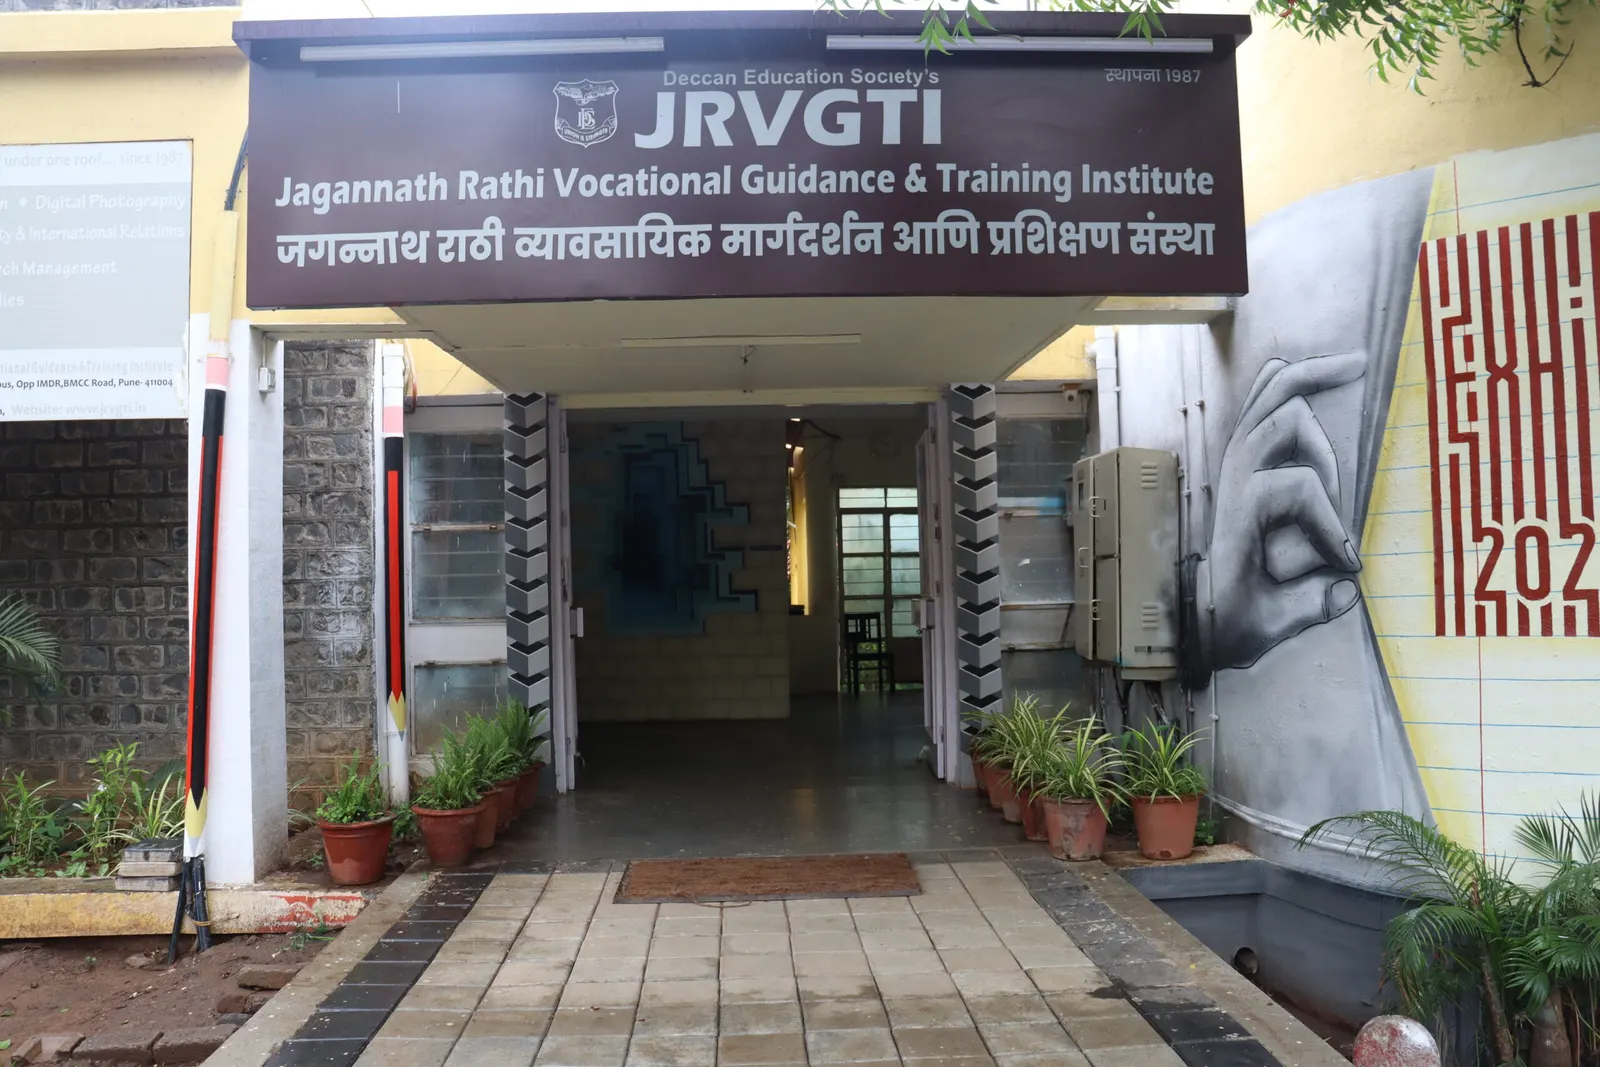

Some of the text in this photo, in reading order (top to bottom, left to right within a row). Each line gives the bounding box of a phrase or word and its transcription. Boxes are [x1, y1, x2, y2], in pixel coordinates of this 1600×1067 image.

[664, 71, 736, 85] Deccan
[745, 69, 843, 84] Education
[1105, 69, 1200, 83] स्थापना 1987
[634, 89, 941, 148] JRVGTI
[5, 154, 43, 168] under
[47, 157, 71, 167] one
[276, 163, 1213, 214] Jagannath Rathi Vocational Guidance & Training Institute
[35, 193, 187, 214] Digital Photography
[29, 224, 117, 243] International
[119, 222, 186, 240] Relations
[277, 209, 1215, 267] जगन्नाथ राठी व्यावसायिक मार्गदर्शन आणि प्रशिक्षण संस्था
[23, 259, 118, 279] Management
[16, 380, 35, 390] Opp
[37, 379, 90, 388] IMDR,BMCC
[91, 378, 117, 388] Road,
[145, 378, 173, 387] 411004
